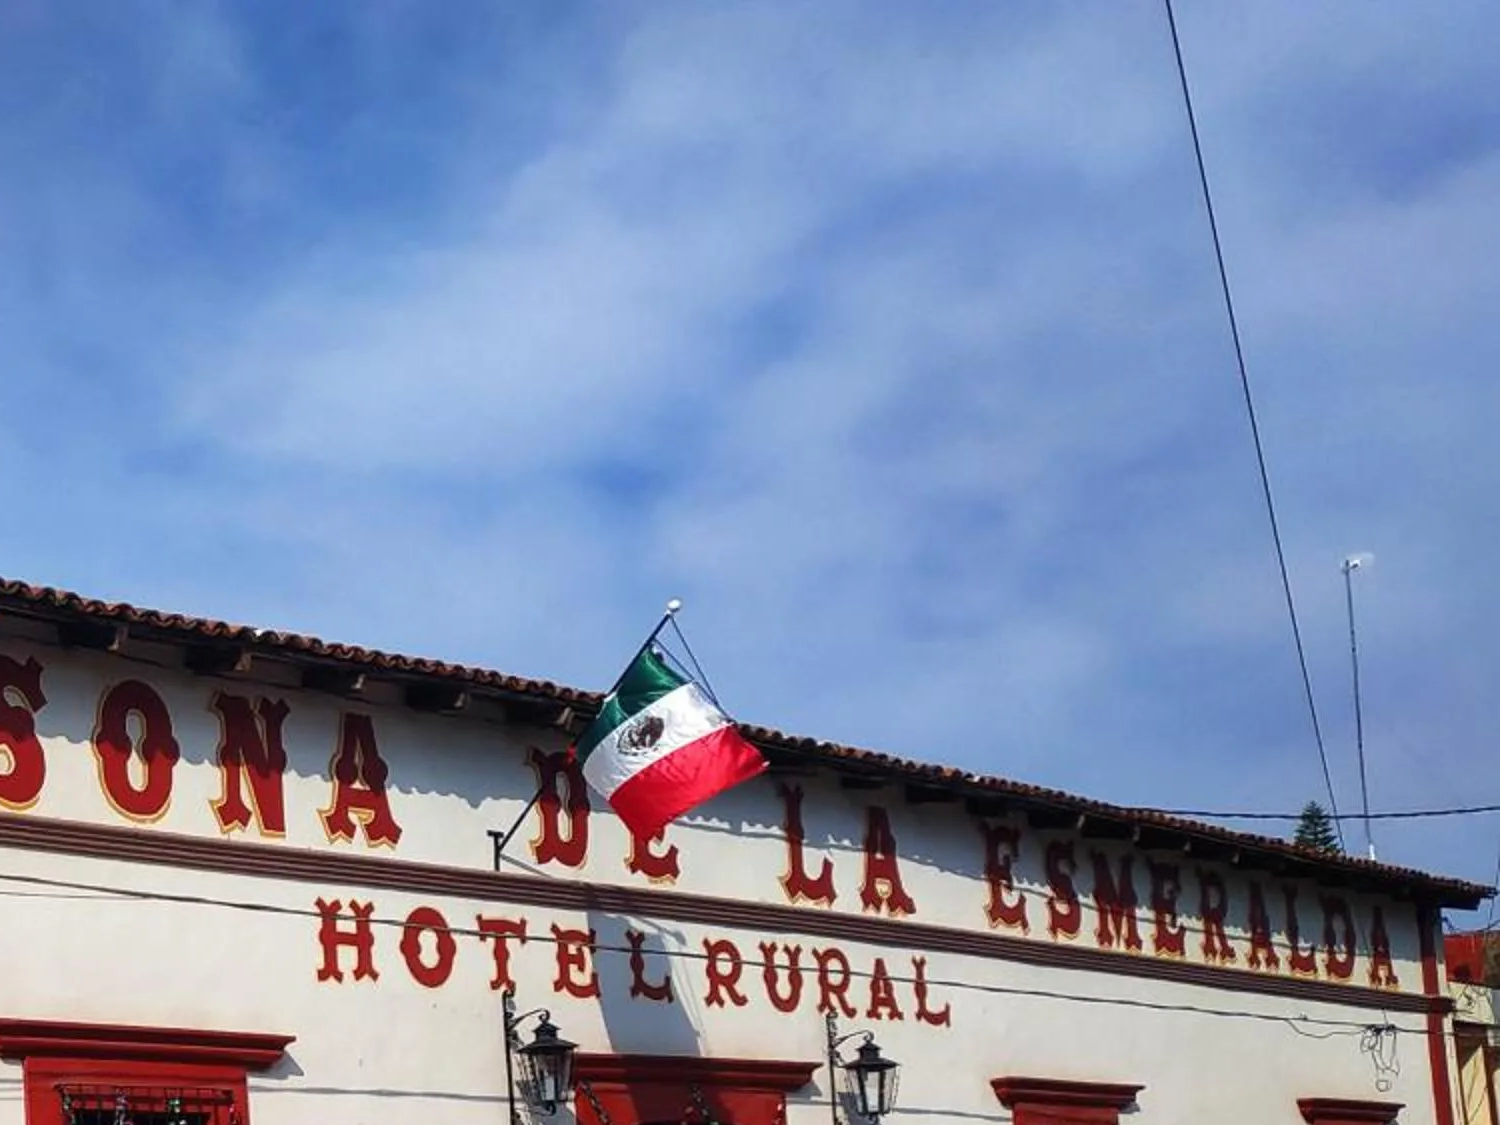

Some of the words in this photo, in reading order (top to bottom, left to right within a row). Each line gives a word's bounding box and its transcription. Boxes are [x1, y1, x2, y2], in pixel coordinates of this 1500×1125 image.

[314, 896, 674, 1003] HOTEL
[702, 937, 952, 1028] RURAL
[776, 781, 916, 918] LA
[976, 820, 1400, 992] ESMERALDA
